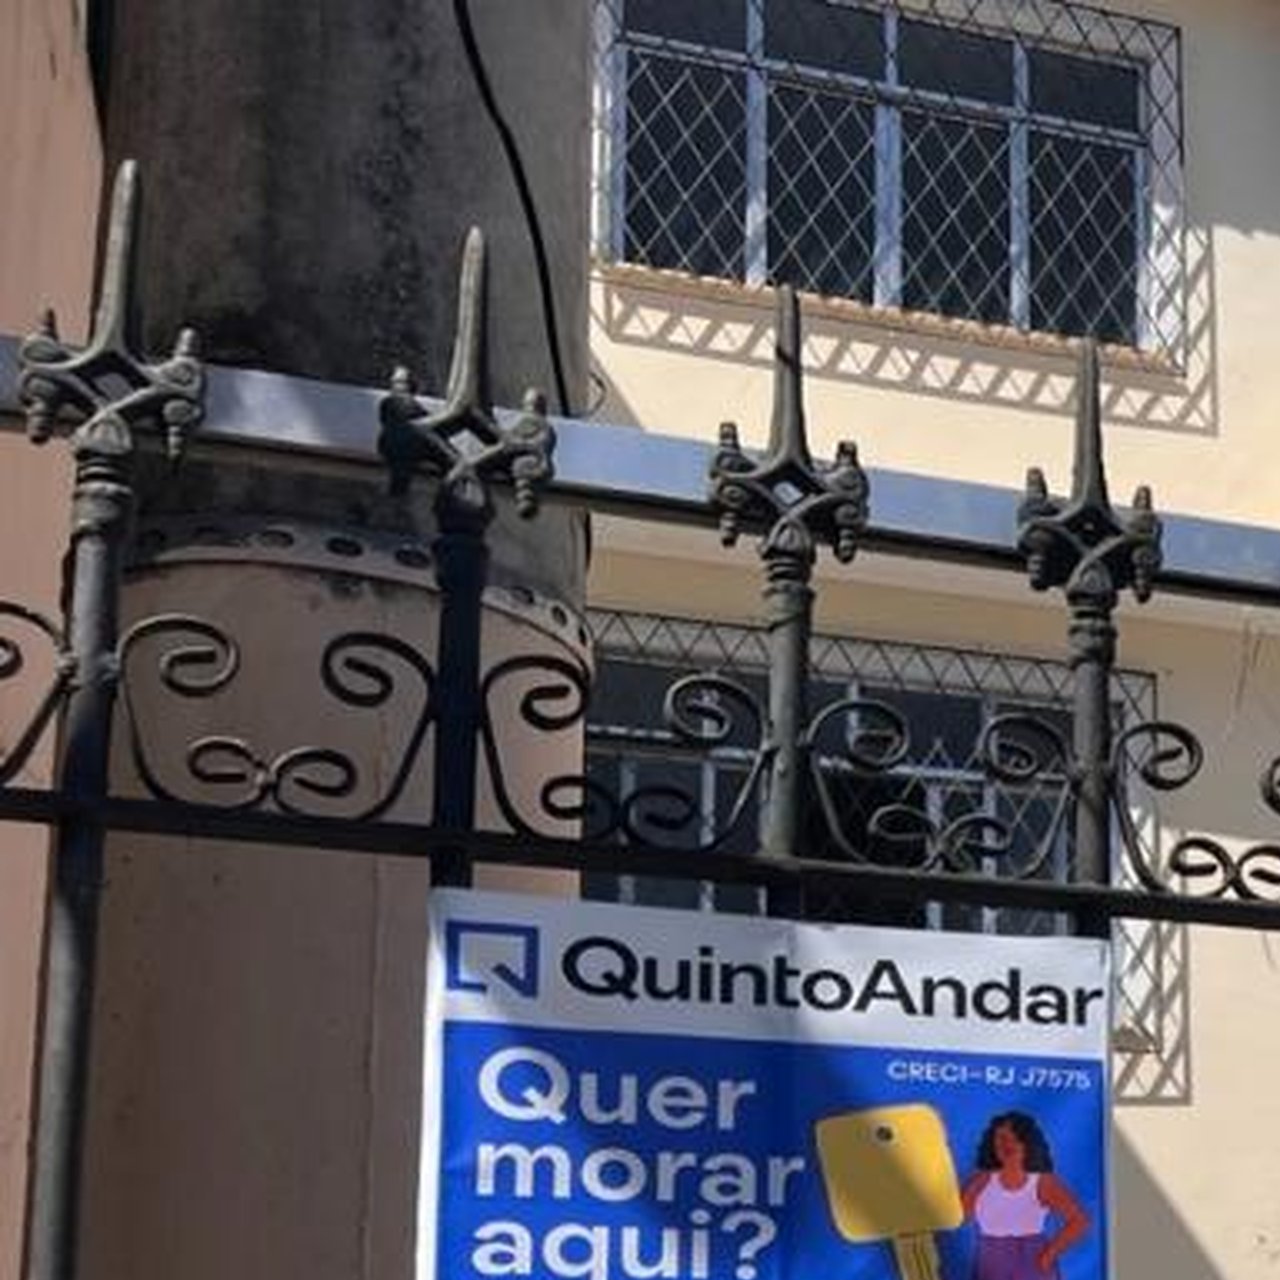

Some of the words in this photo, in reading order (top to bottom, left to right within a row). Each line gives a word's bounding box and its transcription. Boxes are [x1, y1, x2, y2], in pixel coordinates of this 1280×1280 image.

[560, 935, 1105, 1026] QuintoAndar
[476, 1045, 756, 1129] Quer
[886, 1059, 1016, 1085] CRECI-RJ
[1019, 1067, 1092, 1090] J7575
[476, 1141, 803, 1206] morar
